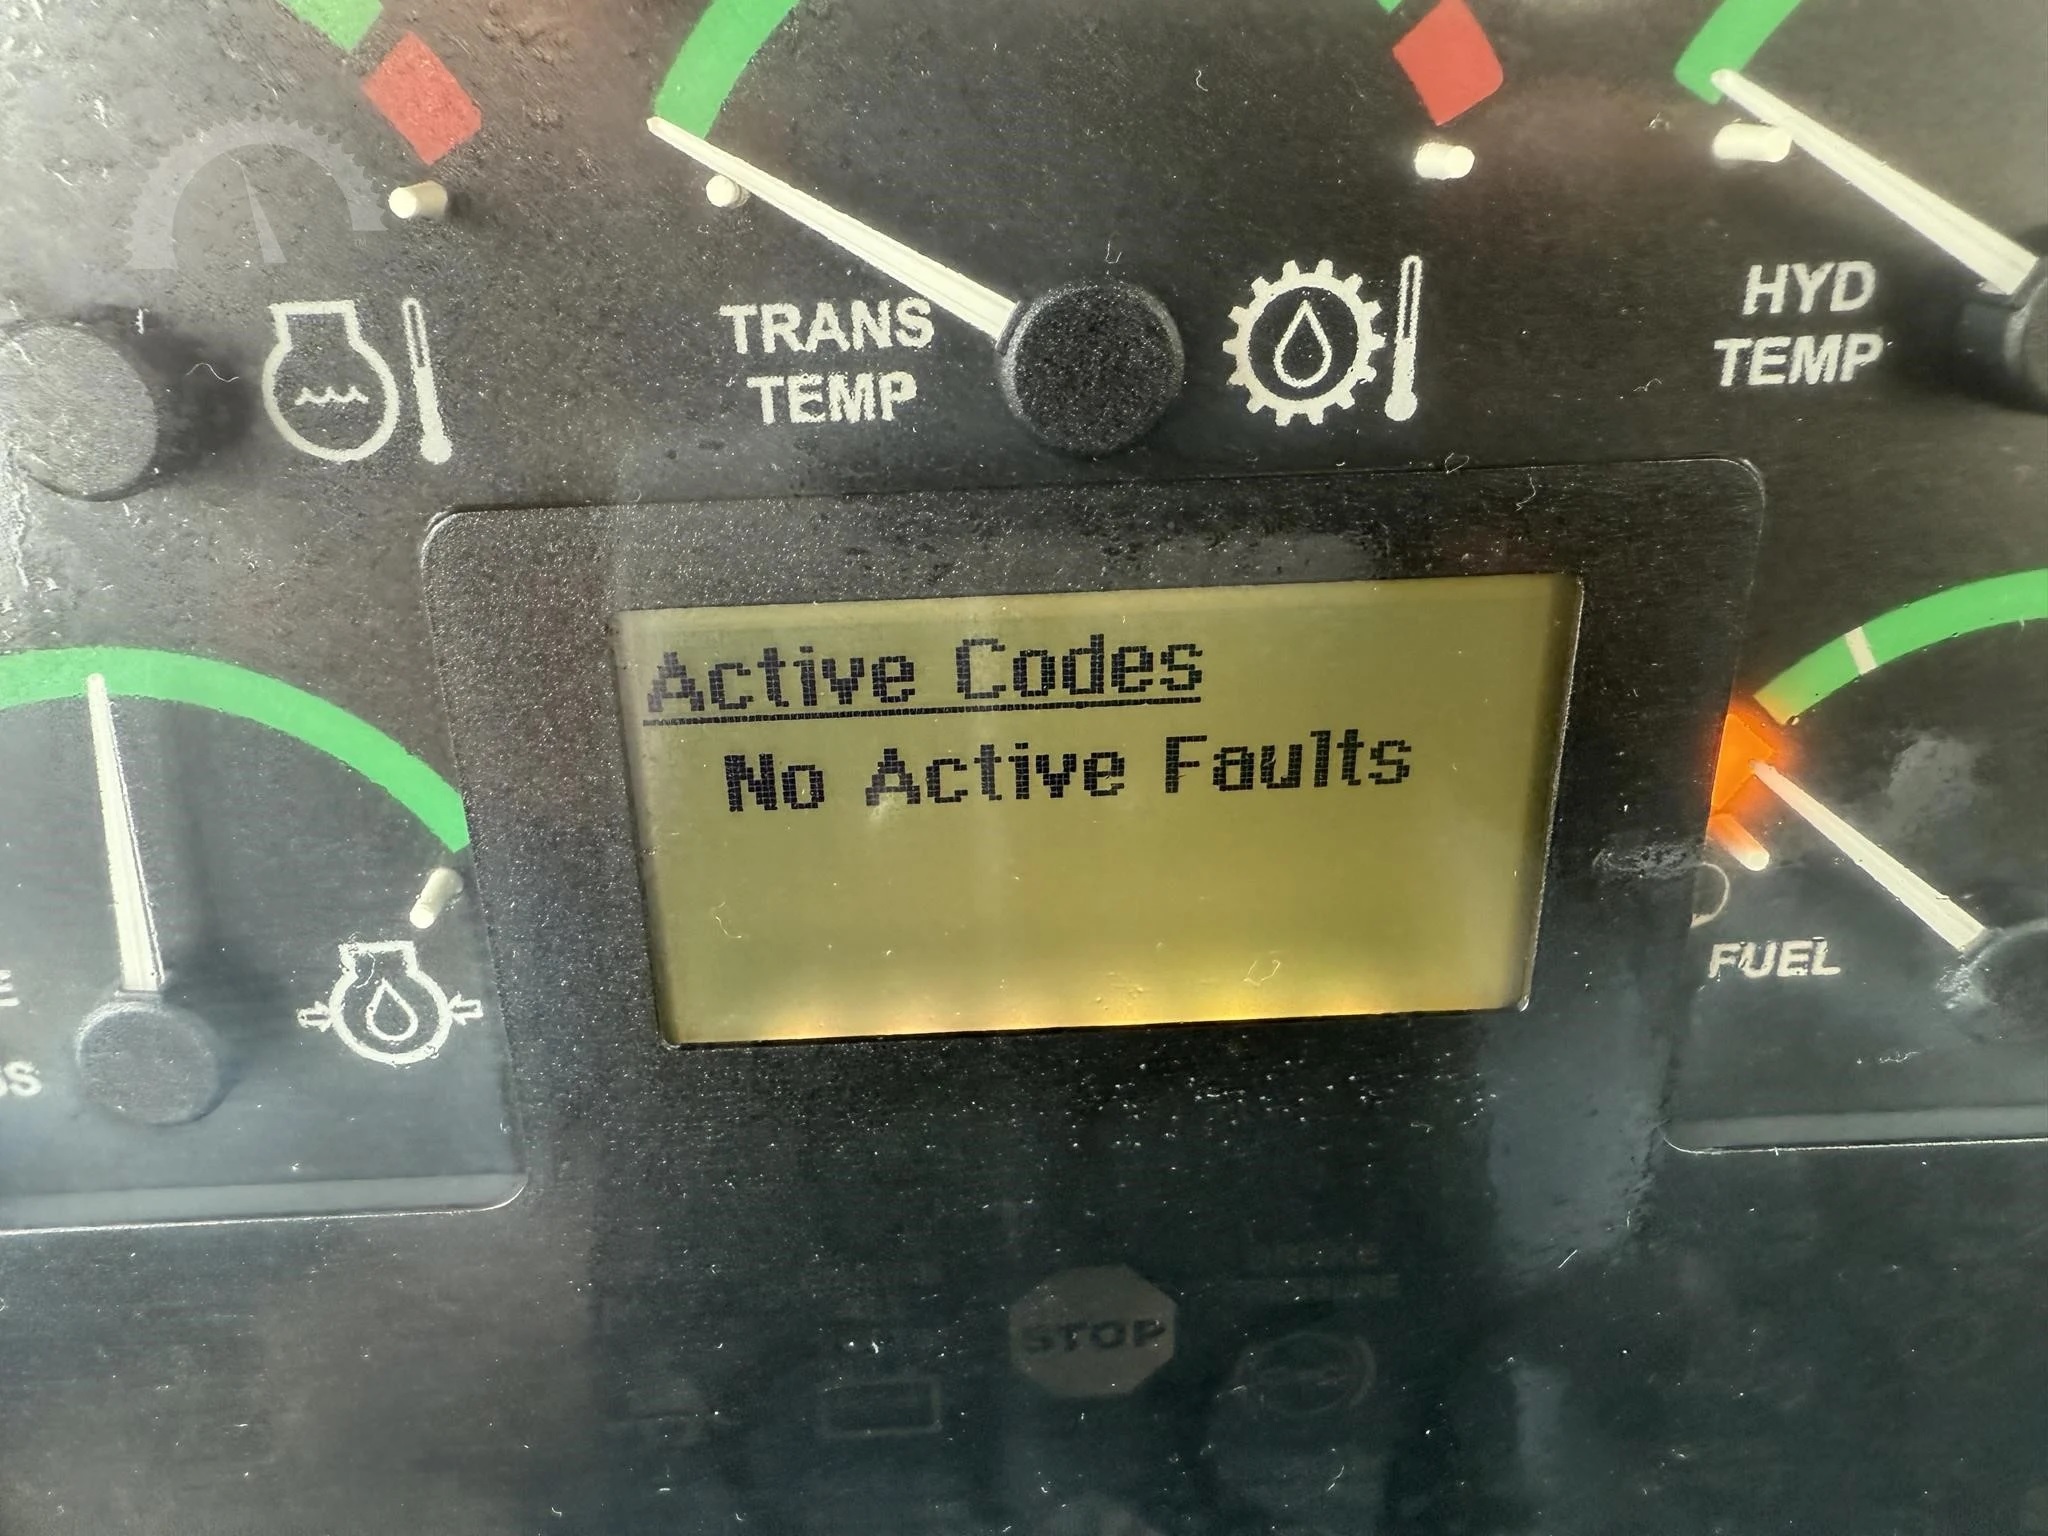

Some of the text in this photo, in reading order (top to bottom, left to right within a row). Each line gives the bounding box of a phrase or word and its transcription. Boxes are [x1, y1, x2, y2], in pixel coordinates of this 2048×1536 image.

[1742, 260, 1876, 315] HYD
[719, 297, 935, 354] TRANS
[1714, 333, 1884, 387] TEMP
[747, 370, 918, 424] TEMP
[647, 633, 1203, 712] Active Codes
[724, 728, 1412, 812] No Active Faults
[1707, 937, 1841, 979] FUEL
[1020, 1319, 1166, 1354] STOP
